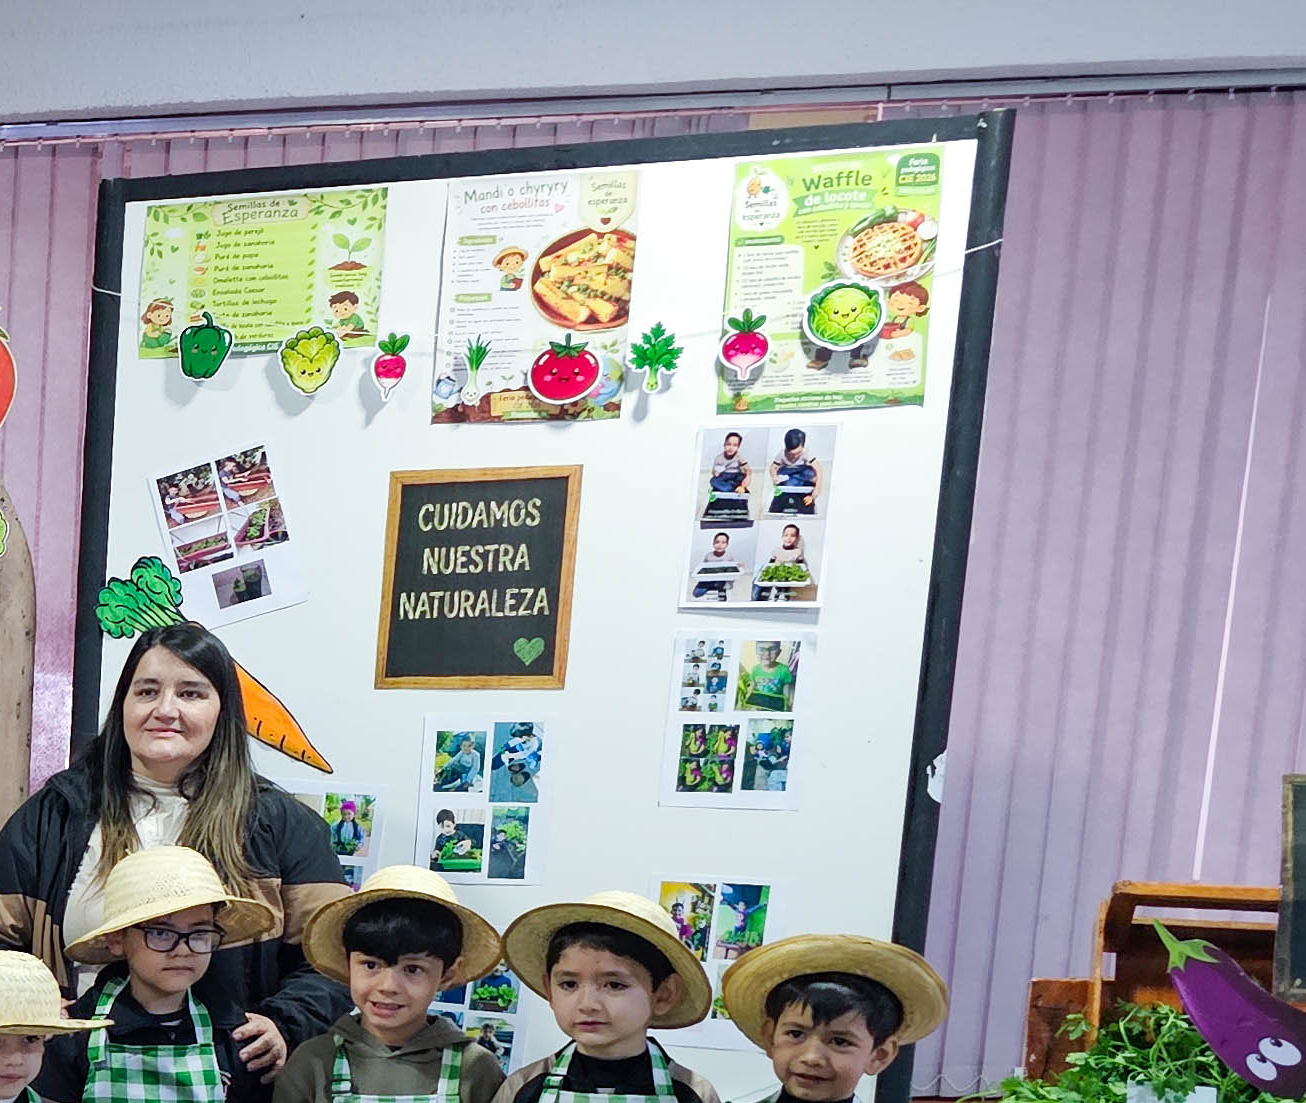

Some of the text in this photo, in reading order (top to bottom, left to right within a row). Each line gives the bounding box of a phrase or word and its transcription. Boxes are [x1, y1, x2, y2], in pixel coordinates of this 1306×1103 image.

[520, 179, 569, 198] chyryry
[802, 170, 872, 191] Waffle
[227, 200, 280, 213] Semillas de
[501, 197, 550, 212] cebollitas
[803, 189, 868, 207] de locote
[222, 207, 299, 226] Esperanza
[417, 498, 541, 532] CUIDAMOS
[421, 543, 531, 576] NUESTRA
[398, 589, 550, 620] NATURALEZA
